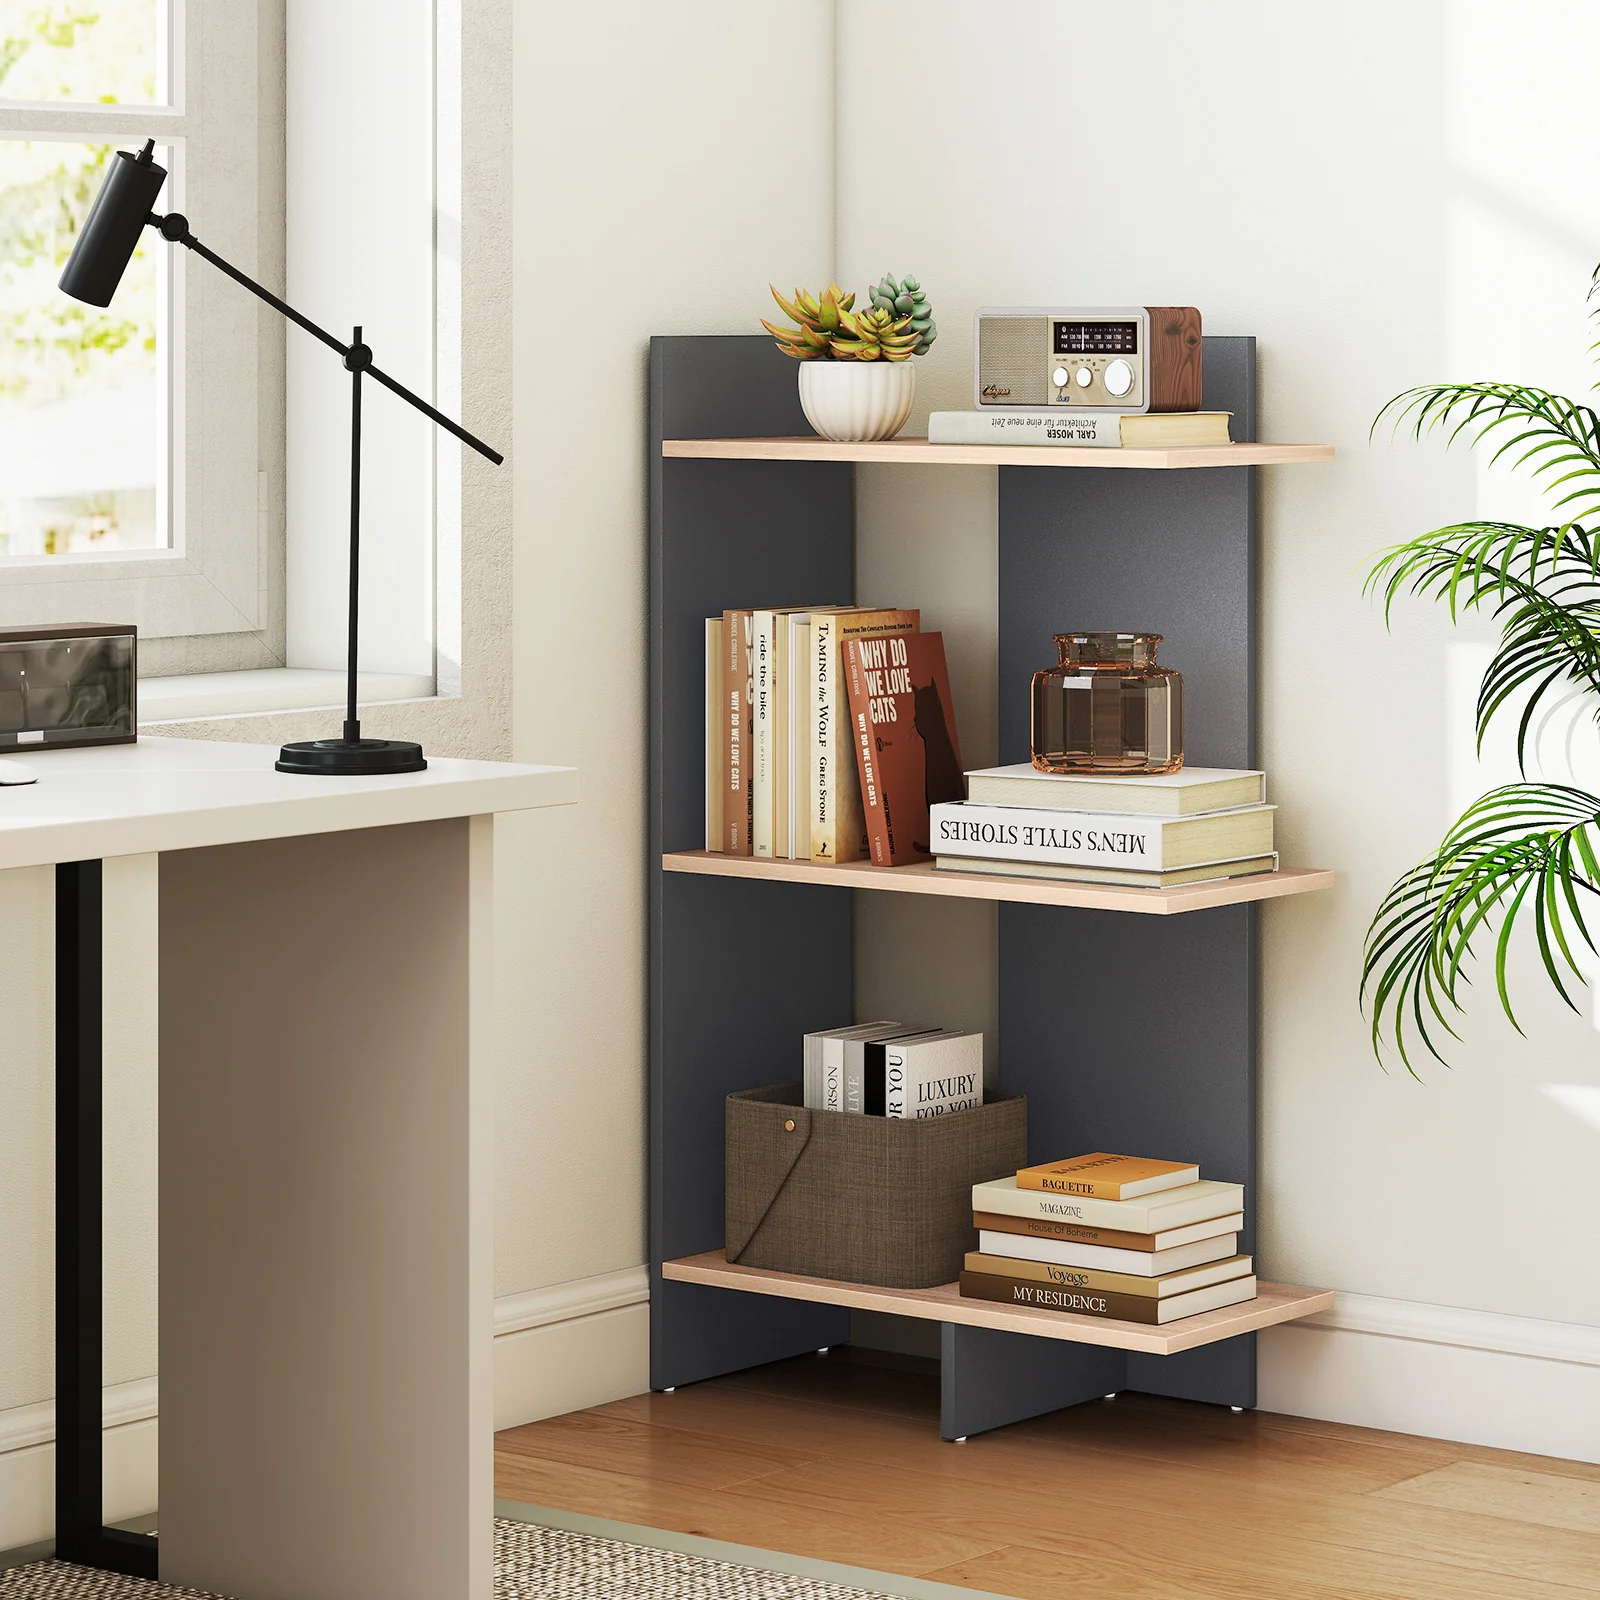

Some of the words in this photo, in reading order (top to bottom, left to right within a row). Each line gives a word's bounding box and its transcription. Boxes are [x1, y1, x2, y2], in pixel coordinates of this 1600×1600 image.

[991, 418, 1006, 428] Zeit
[1007, 418, 1025, 426] neue
[1026, 418, 1042, 428] eine
[1043, 418, 1055, 428] für
[1056, 419, 1097, 429] Architektur
[1046, 429, 1074, 439] MOSER
[1076, 430, 1097, 439] CARL
[818, 623, 829, 682] TAMING
[858, 639, 888, 669] WHY
[890, 638, 908, 667] DO
[864, 670, 885, 697] WE
[884, 668, 913, 695] LOVE
[731, 691, 740, 712] WHY
[818, 687, 827, 703] the
[731, 713, 740, 726] DO
[869, 696, 898, 724] CATS
[818, 705, 829, 747] WOLF
[857, 713, 867, 732] WHY
[731, 728, 740, 742] WE
[860, 734, 869, 746] DO
[731, 744, 740, 766] LOVE
[862, 747, 871, 761] WE
[731, 767, 740, 790] CATS
[819, 756, 827, 787] GREG
[864, 762, 874, 784] LOVE
[819, 789, 827, 823] STONE
[867, 785, 877, 807] CATS
[940, 820, 1018, 845] STORIES
[1023, 826, 1082, 850] STYLE
[1087, 831, 1146, 855] MEN'S
[888, 1053, 903, 1095] YOU
[848, 1076, 860, 1112] LIVE
[918, 1073, 977, 1103] LUXURY
[1042, 1178, 1094, 1194] BAGUETTE
[1039, 1202, 1083, 1219] MAGAZINE
[1028, 1222, 1052, 1233] House
[1054, 1225, 1065, 1234] Of
[1066, 1227, 1099, 1239] Boheme
[1047, 1266, 1089, 1287] Voyage
[1013, 1286, 1034, 1301] MY
[1036, 1289, 1107, 1313] RESIDENCE
